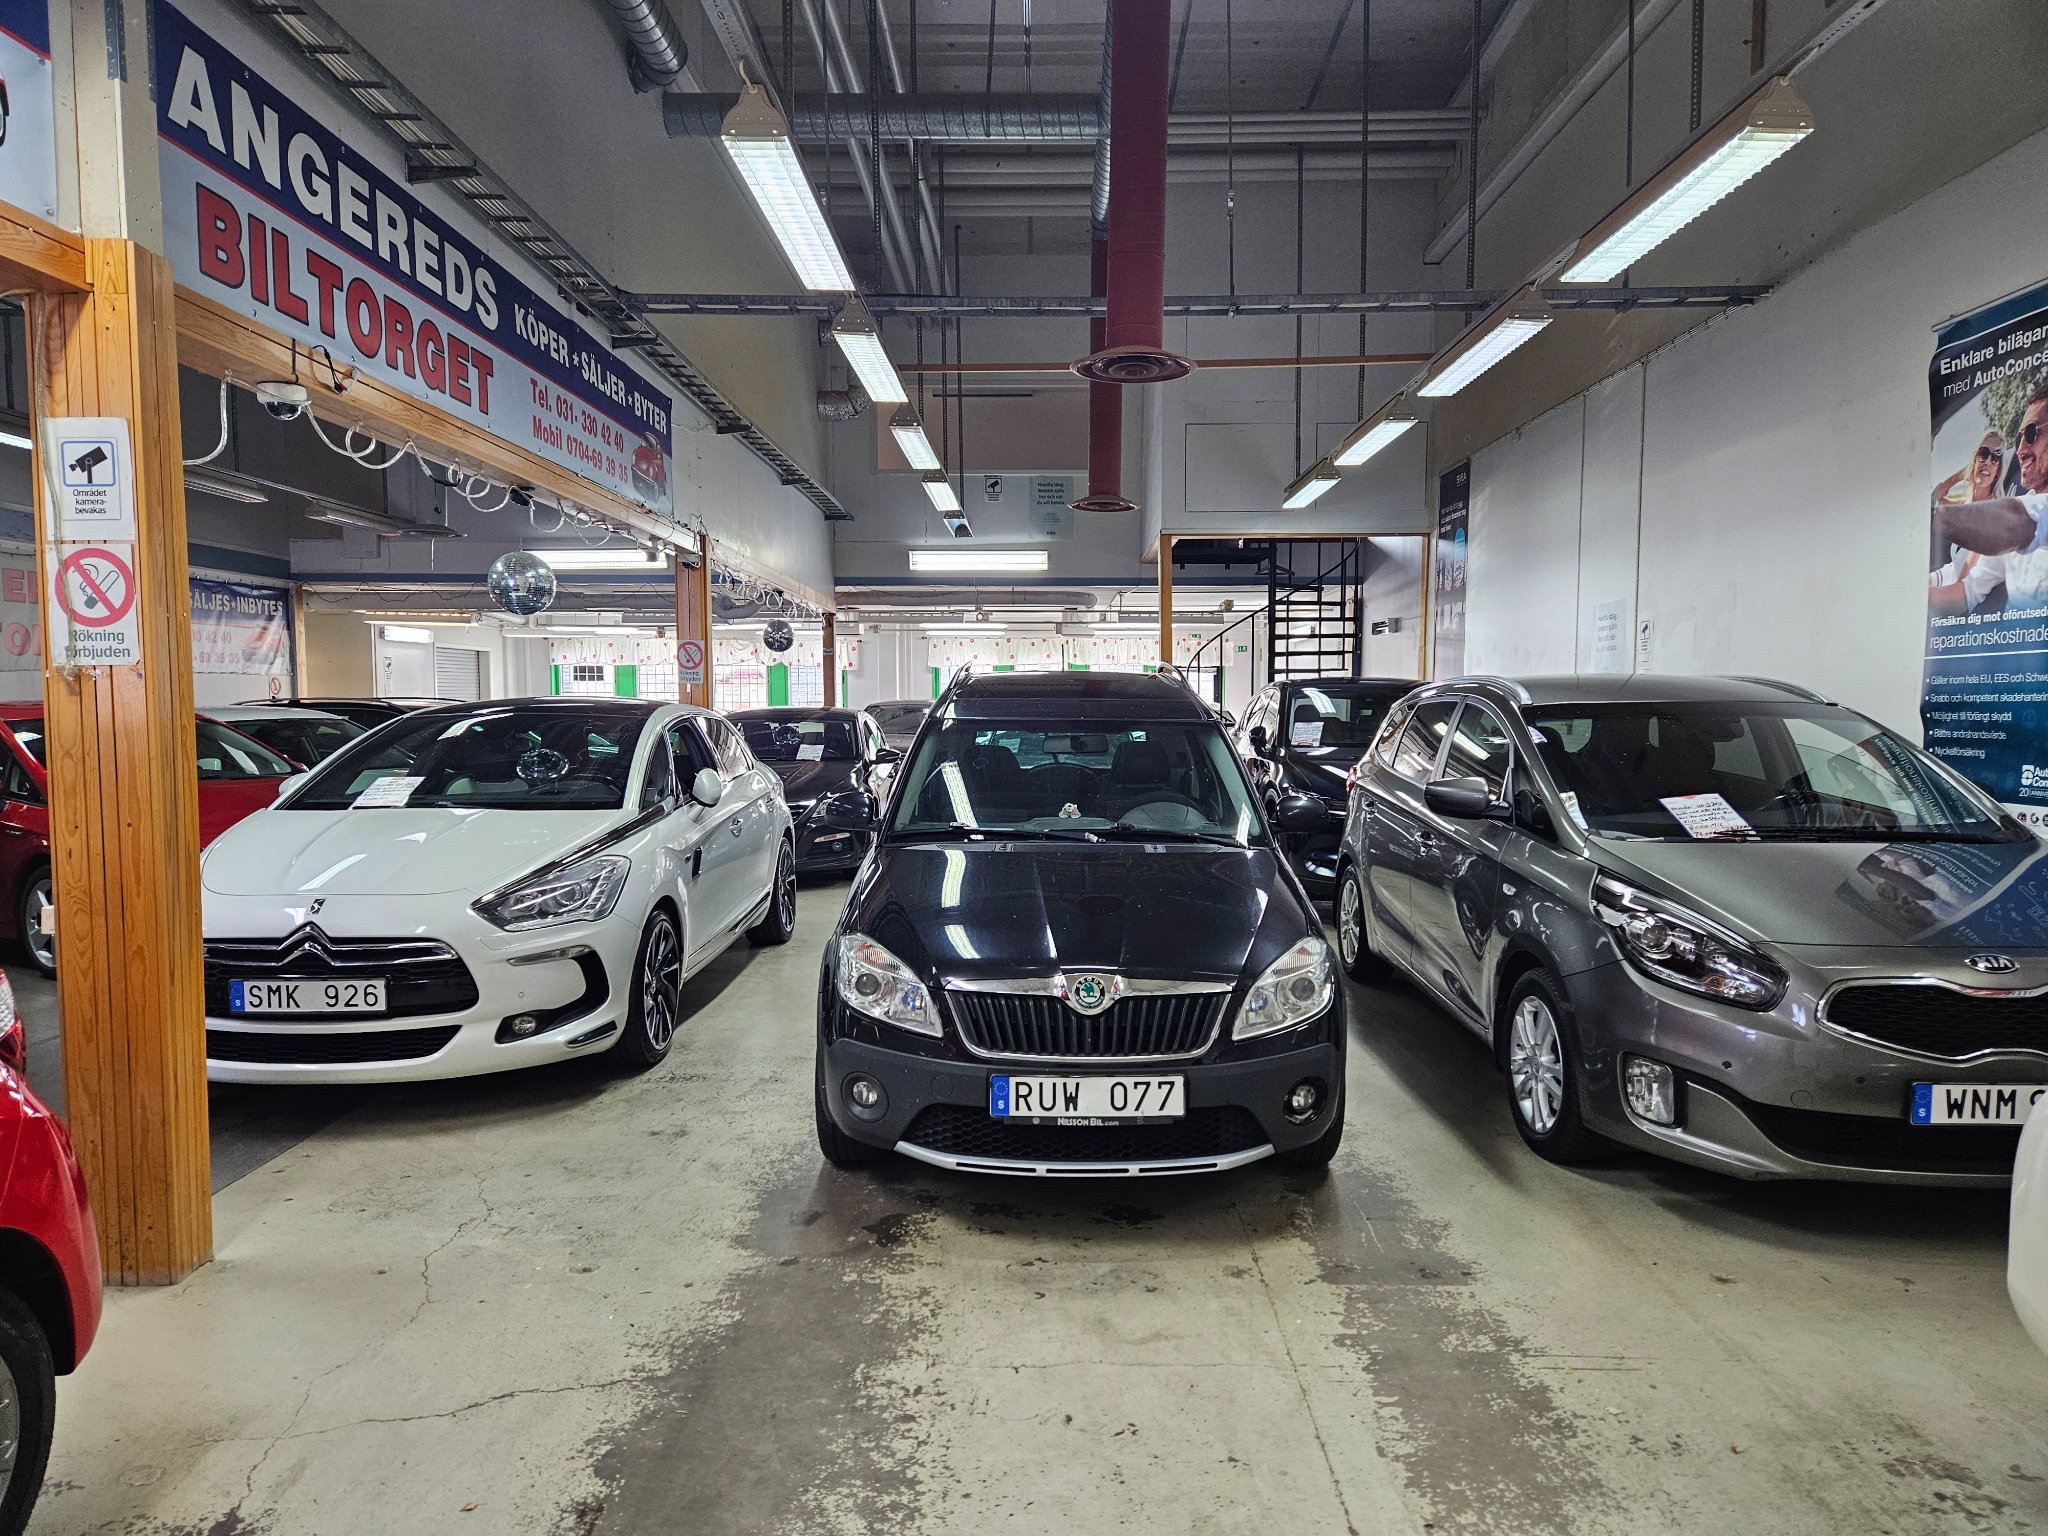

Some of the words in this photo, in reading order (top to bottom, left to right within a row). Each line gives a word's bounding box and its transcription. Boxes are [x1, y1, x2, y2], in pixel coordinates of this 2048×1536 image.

[166, 42, 500, 333] ANGEREDS
[195, 181, 494, 416] BILTORGET
[514, 303, 570, 369] KÖPER
[581, 351, 627, 408] SÄLJER
[633, 391, 667, 435] BYTER
[1939, 346, 1994, 376] Enklare
[1943, 375, 1971, 398] med
[530, 378, 552, 413] Tel.
[556, 394, 578, 425] 031-
[581, 410, 598, 439] 330
[601, 422, 611, 447] 42
[614, 431, 624, 454] 40
[532, 415, 562, 451] Mobil
[566, 434, 603, 471] 0704-69
[606, 456, 616, 478] 39
[619, 463, 628, 484] 35
[72, 488, 107, 497] Området
[75, 506, 107, 514] bevakas
[236, 596, 283, 616] INBYTES
[1931, 615, 1966, 627] Försäkra
[1967, 613, 1981, 625] dig
[1983, 611, 2001, 623] mot
[205, 631, 217, 643] 42
[221, 631, 232, 644] 40
[1931, 676, 1948, 685] Gäller
[1965, 675, 1979, 684] hela
[1994, 673, 2009, 683] EES
[2010, 673, 2024, 682] och
[1930, 694, 1950, 703] Snabb
[1951, 694, 1963, 703] och
[1963, 693, 1999, 703] kompetent
[1991, 712, 2012, 722] skydd
[249, 984, 301, 1008] SMK
[324, 983, 378, 1008] 926
[997, 1100, 1005, 1110] S
[1015, 1081, 1080, 1112] RUW
[1110, 1081, 1176, 1112] 077
[1946, 1089, 2017, 1119] WNM
[1918, 1108, 1926, 1117] S
